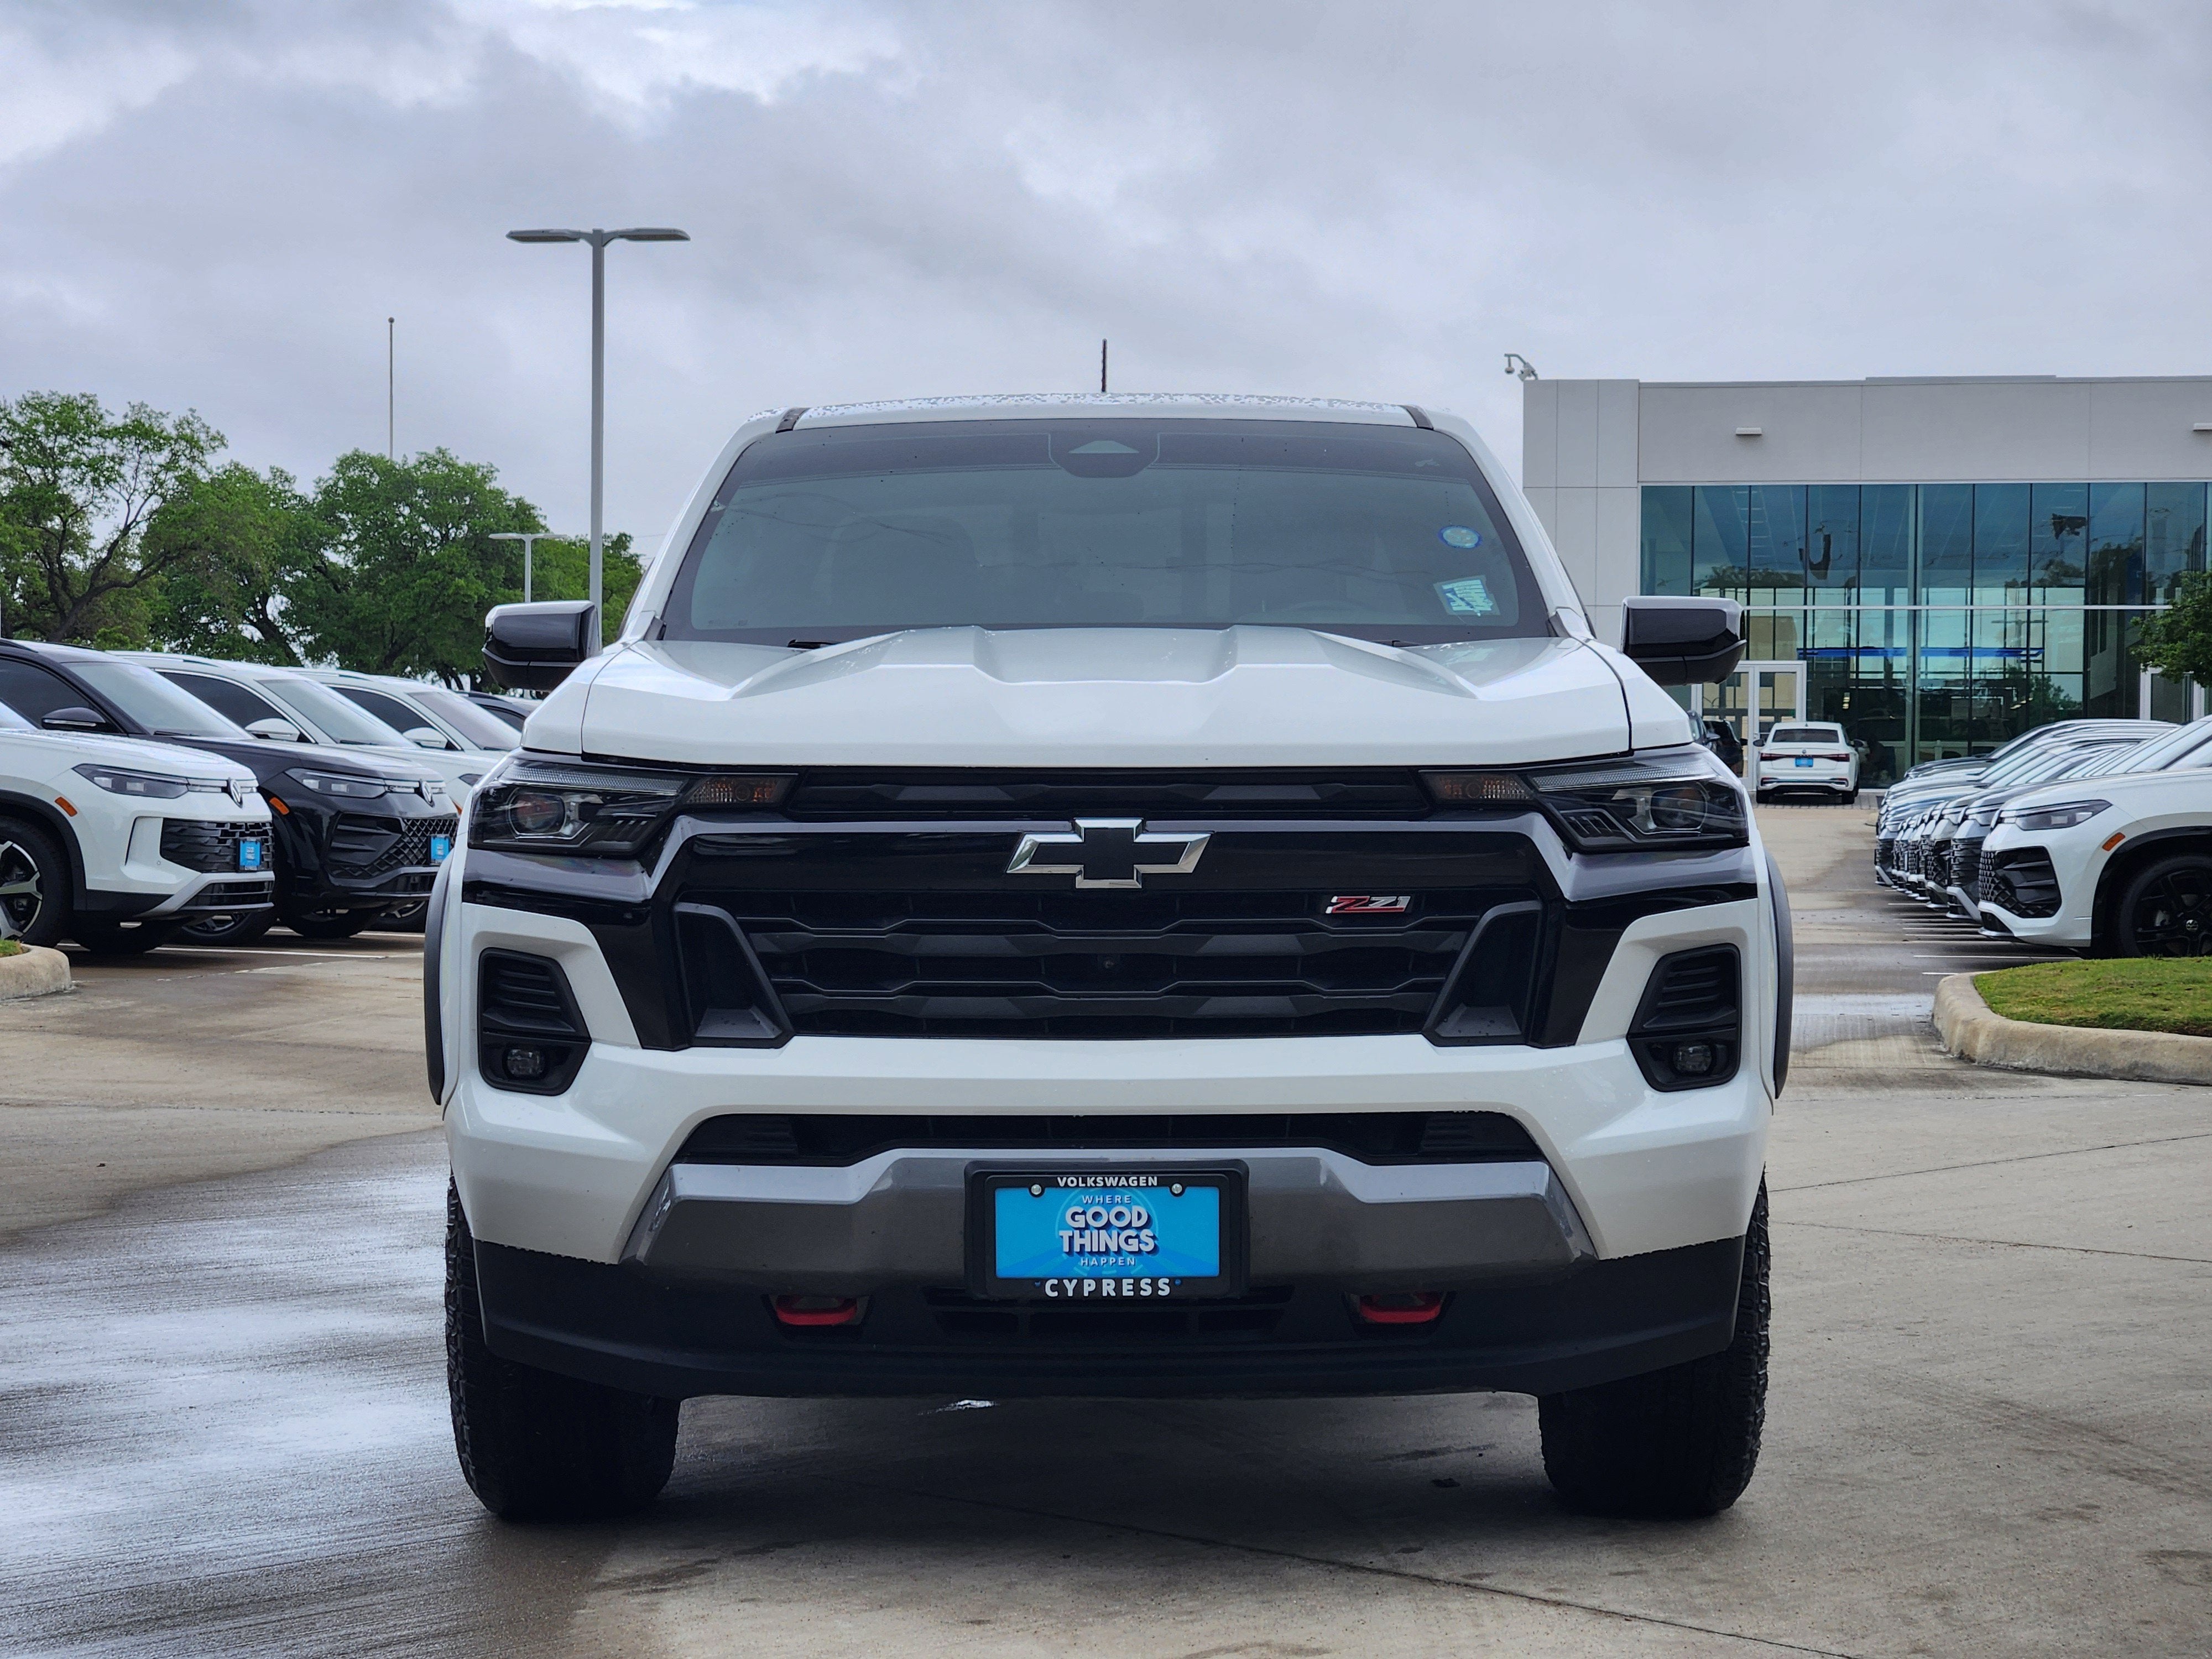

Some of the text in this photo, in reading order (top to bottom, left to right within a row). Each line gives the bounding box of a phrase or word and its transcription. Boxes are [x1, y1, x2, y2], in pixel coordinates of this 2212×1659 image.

[1325, 895, 1411, 914] Z71
[1057, 1176, 1157, 1187] VOLKSWAGEN
[1082, 1195, 1131, 1203] WHERE
[1065, 1206, 1147, 1228] GOOD
[1058, 1229, 1154, 1252] THINGS
[1081, 1257, 1135, 1266] HAPPEN
[1045, 1278, 1170, 1297] CYPRESS
